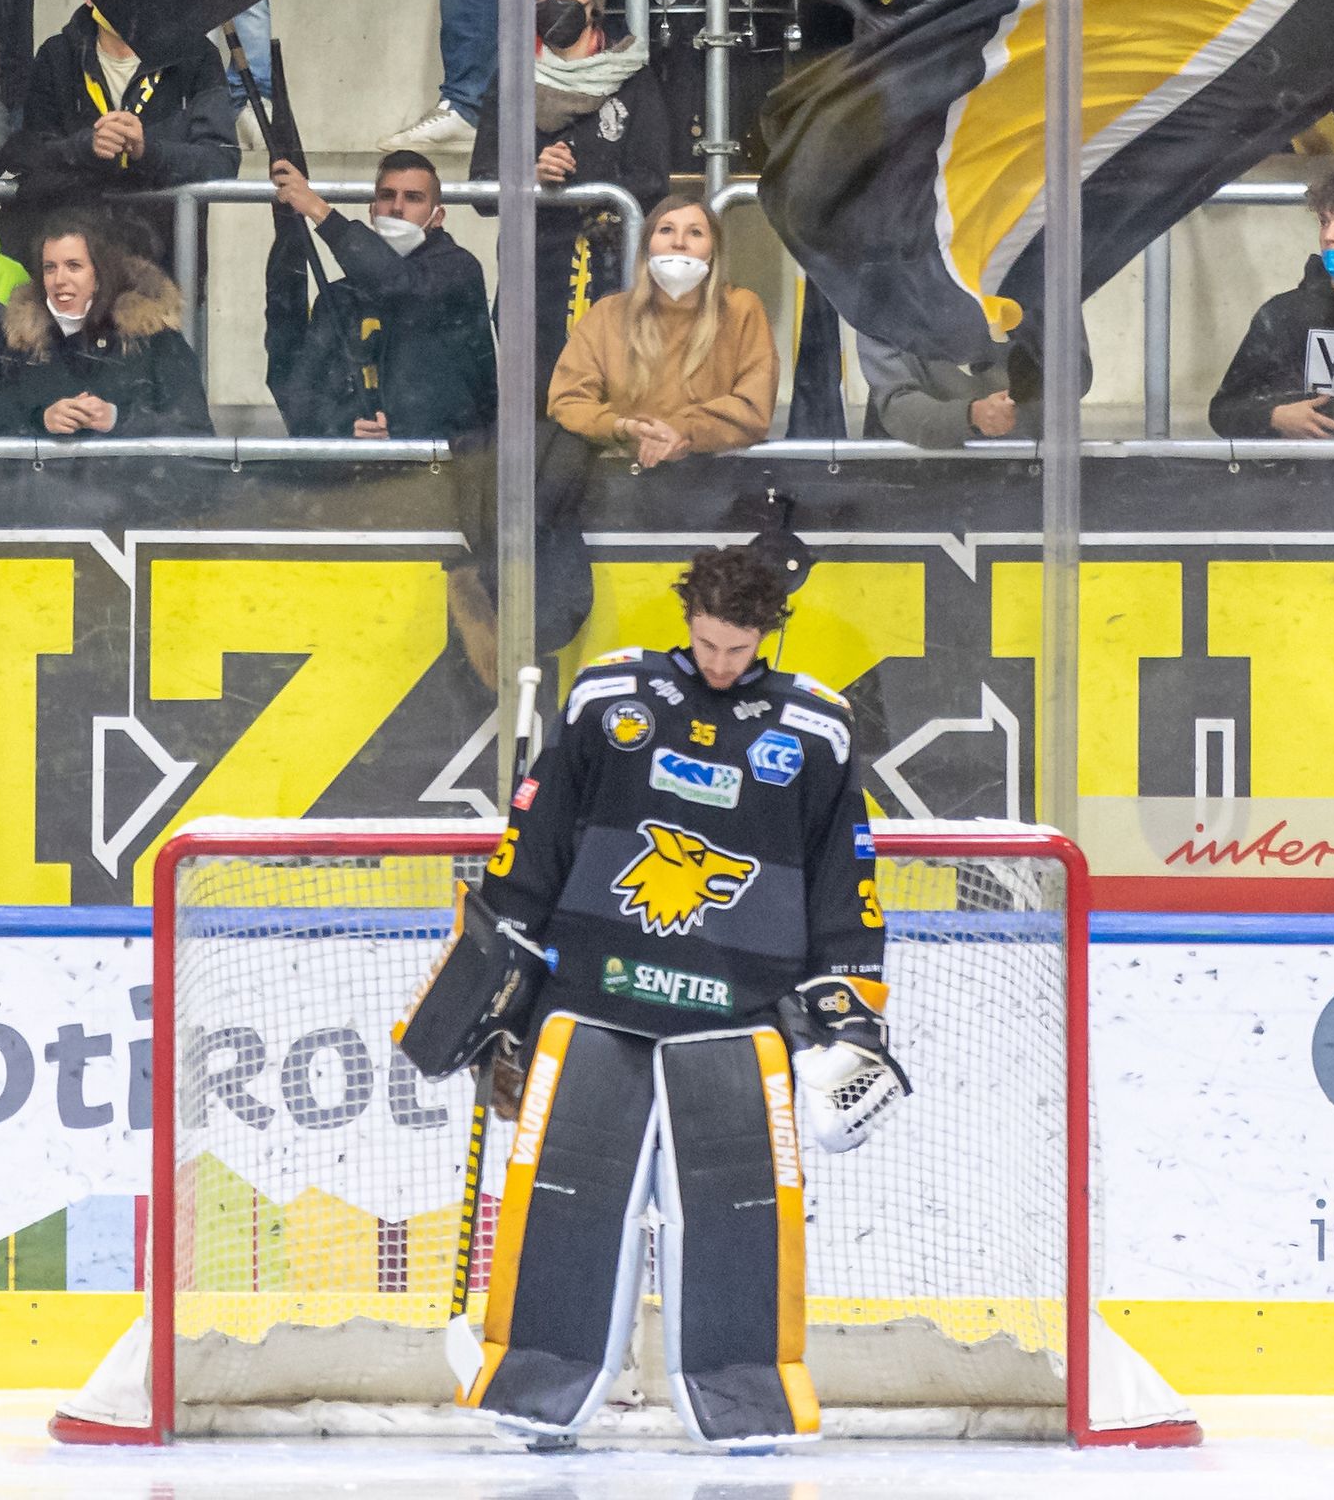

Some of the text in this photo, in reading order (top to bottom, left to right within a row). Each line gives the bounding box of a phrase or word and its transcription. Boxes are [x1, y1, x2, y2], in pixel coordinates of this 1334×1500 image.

[689, 720, 718, 747] 35
[633, 963, 730, 1006] SENFTER
[512, 1051, 560, 1166] VAUGHN
[764, 1071, 801, 1189] VAUGHN
